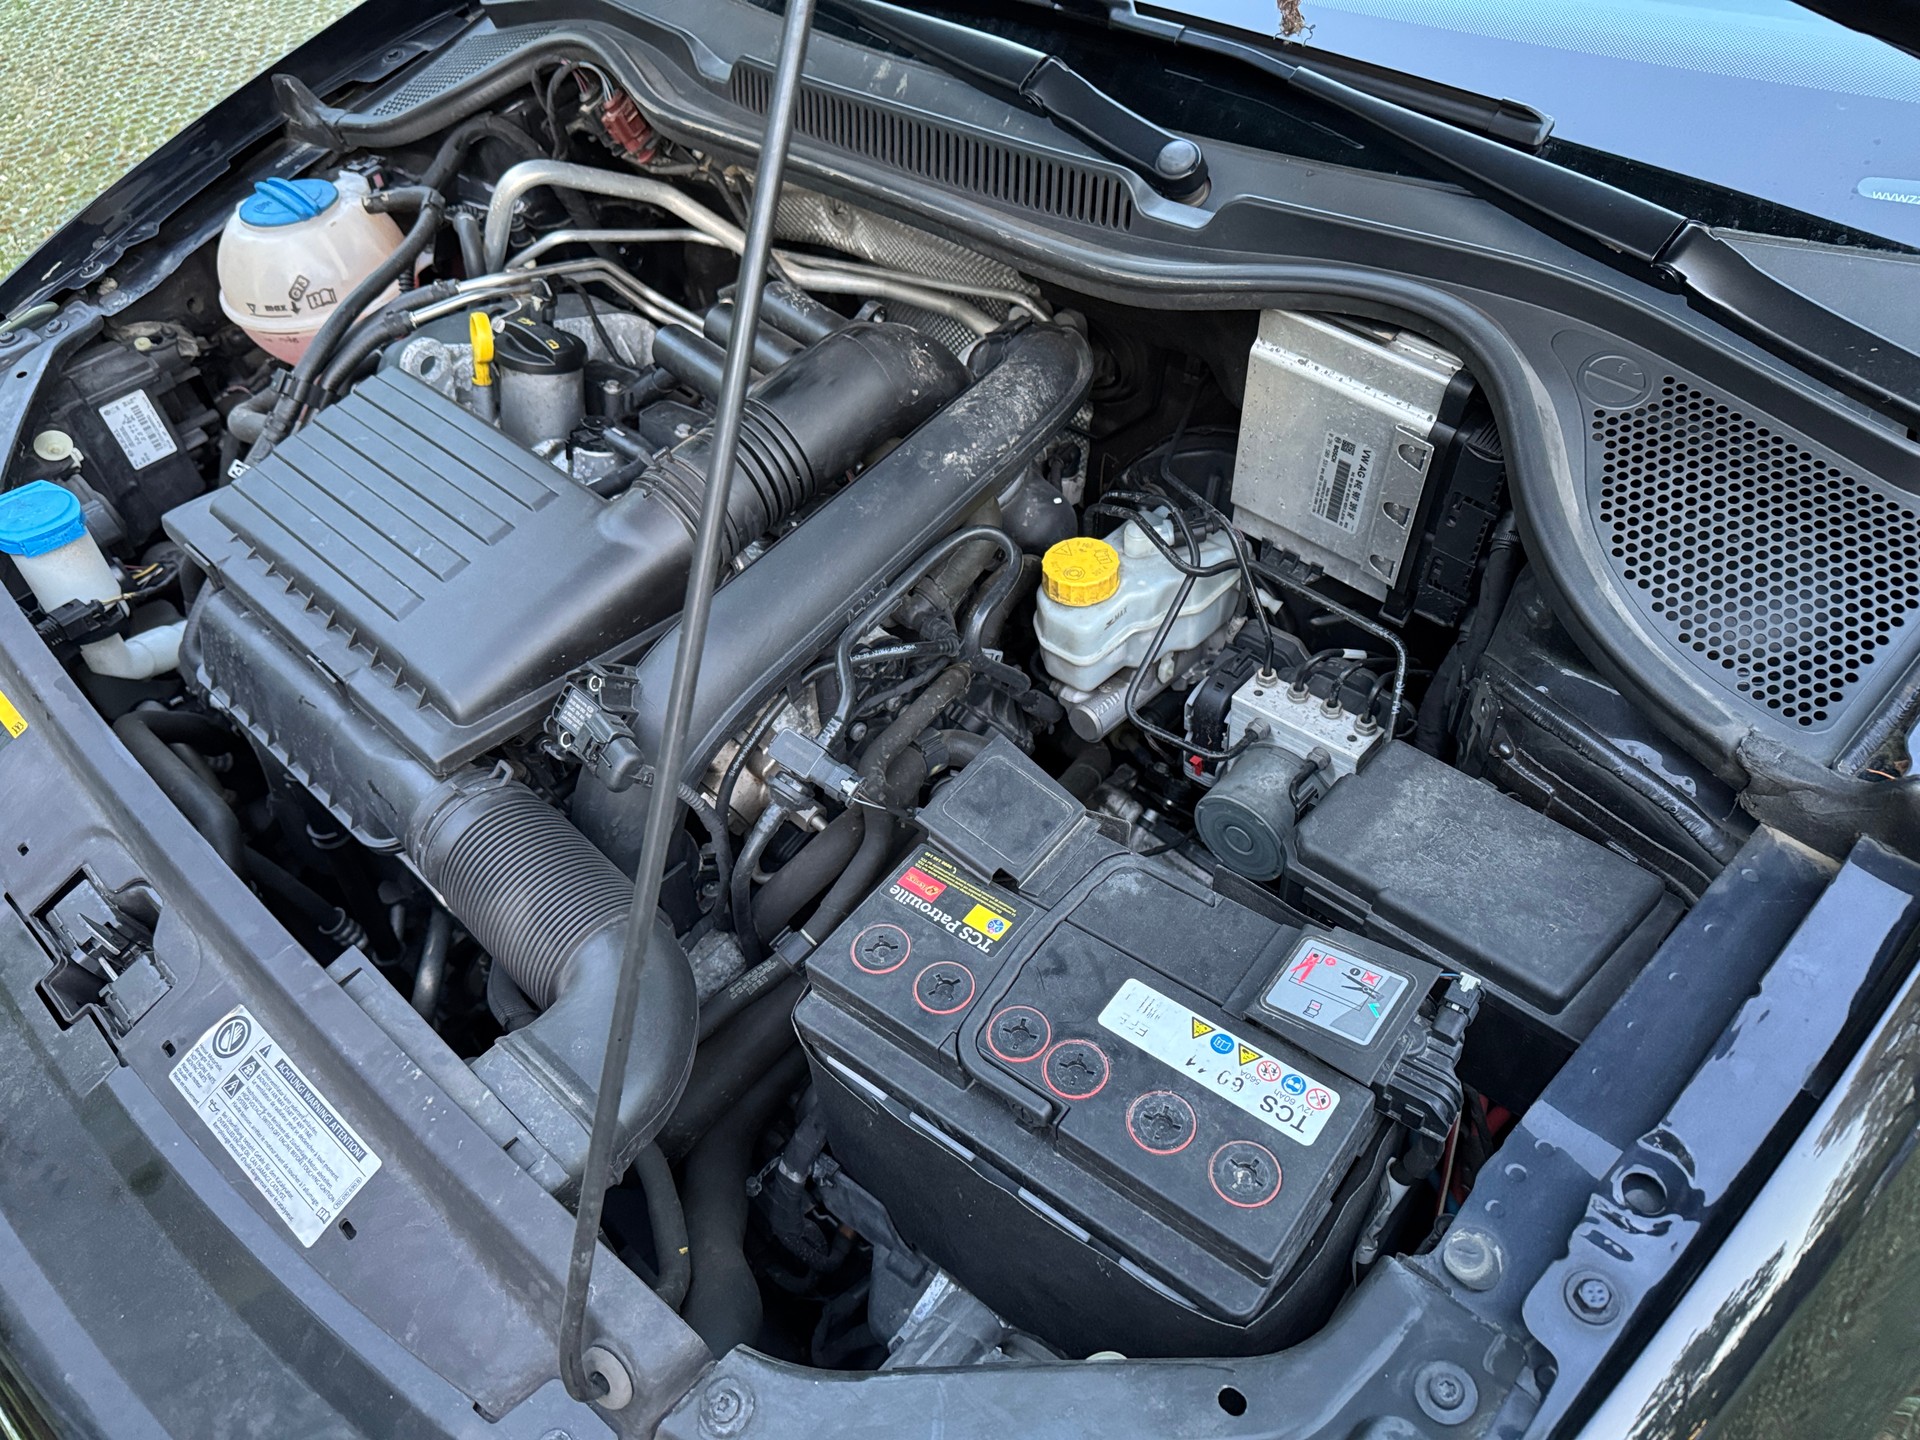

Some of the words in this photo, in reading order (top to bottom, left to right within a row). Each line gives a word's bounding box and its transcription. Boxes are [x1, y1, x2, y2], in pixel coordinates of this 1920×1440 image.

[1872, 190, 1920, 205] WVWZ
[1329, 444, 1339, 463] BOSCH
[1359, 448, 1371, 465] VW
[1355, 464, 1367, 479] AG
[1113, 605, 1127, 621] MAX
[886, 882, 962, 933] Patrouille
[957, 924, 994, 952] TCS
[1237, 1068, 1262, 1086] 560A
[1271, 1087, 1297, 1106] 60Ah
[276, 1060, 307, 1095] ACHTUNG!
[302, 1089, 333, 1125] WARNING!
[328, 1119, 364, 1160] ATTENTION!
[1256, 1092, 1308, 1134] TCS
[1295, 1102, 1315, 1117] 12V
